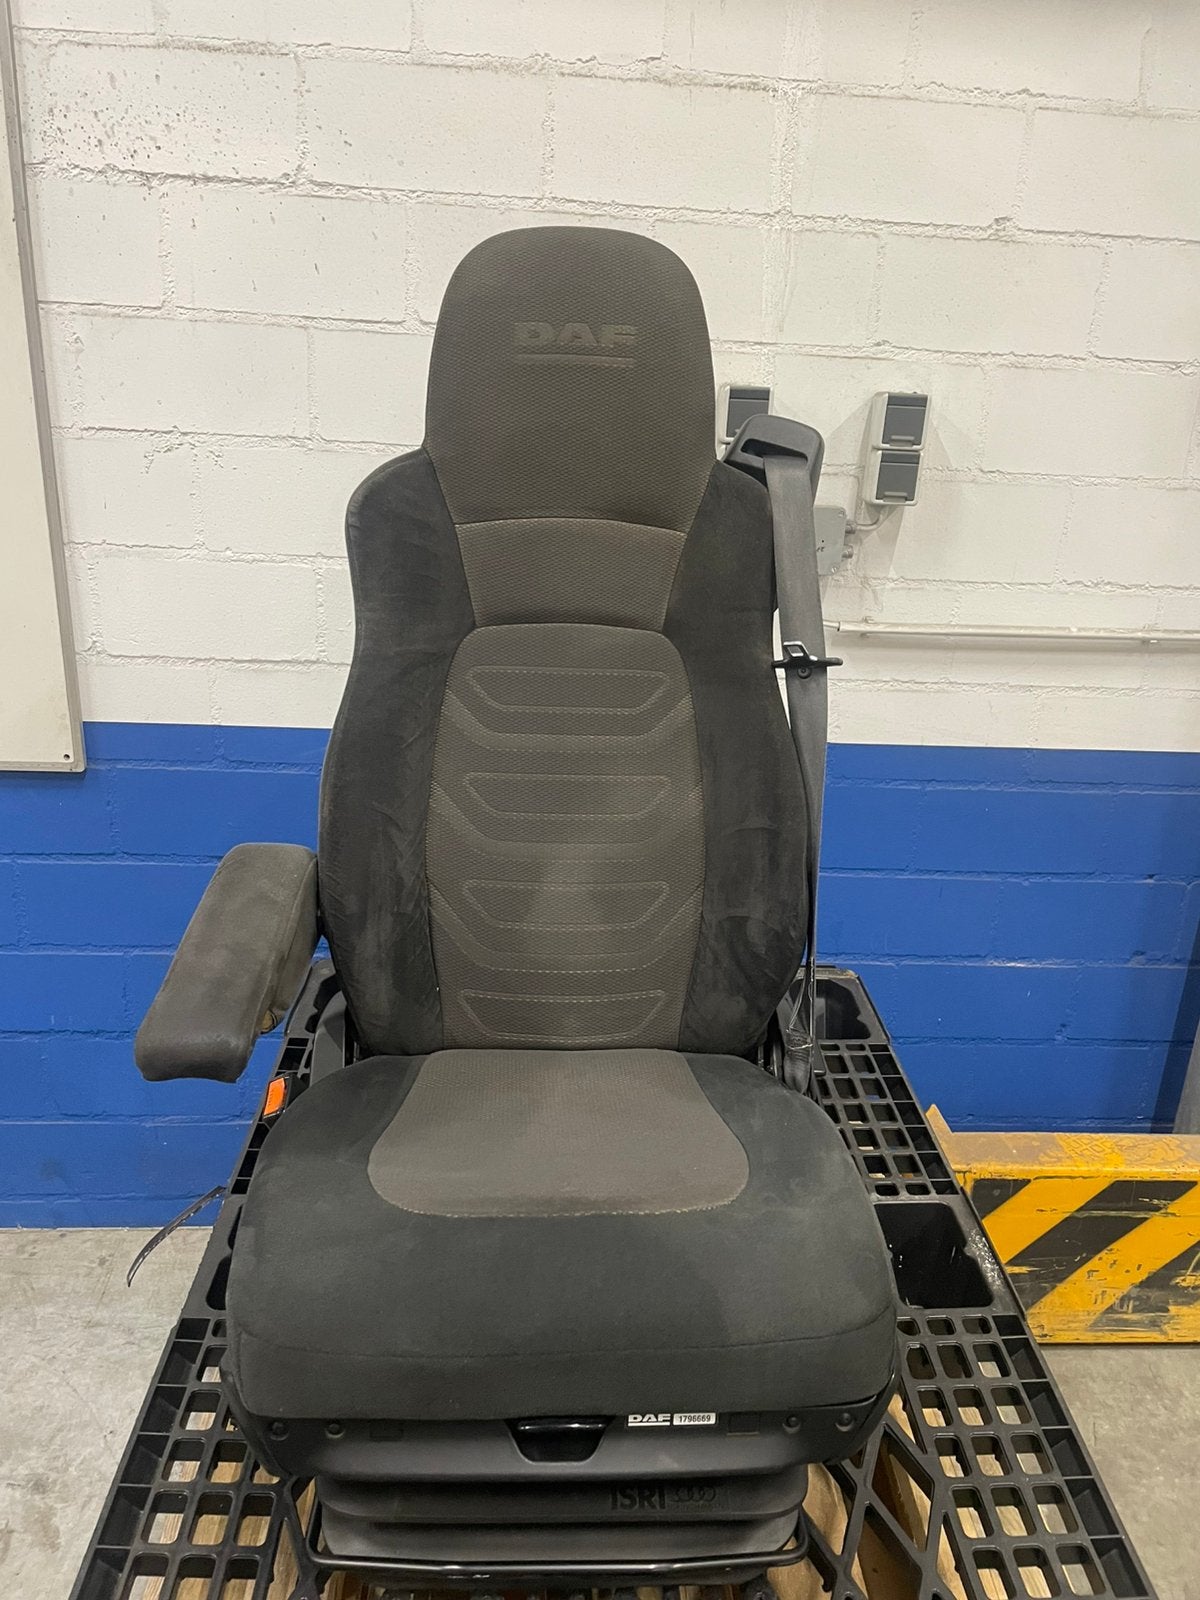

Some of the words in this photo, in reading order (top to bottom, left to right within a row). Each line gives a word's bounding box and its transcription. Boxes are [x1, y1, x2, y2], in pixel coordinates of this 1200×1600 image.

[513, 322, 637, 347] DAF
[628, 1413, 671, 1422] DAF
[611, 1485, 666, 1511] ISRI
